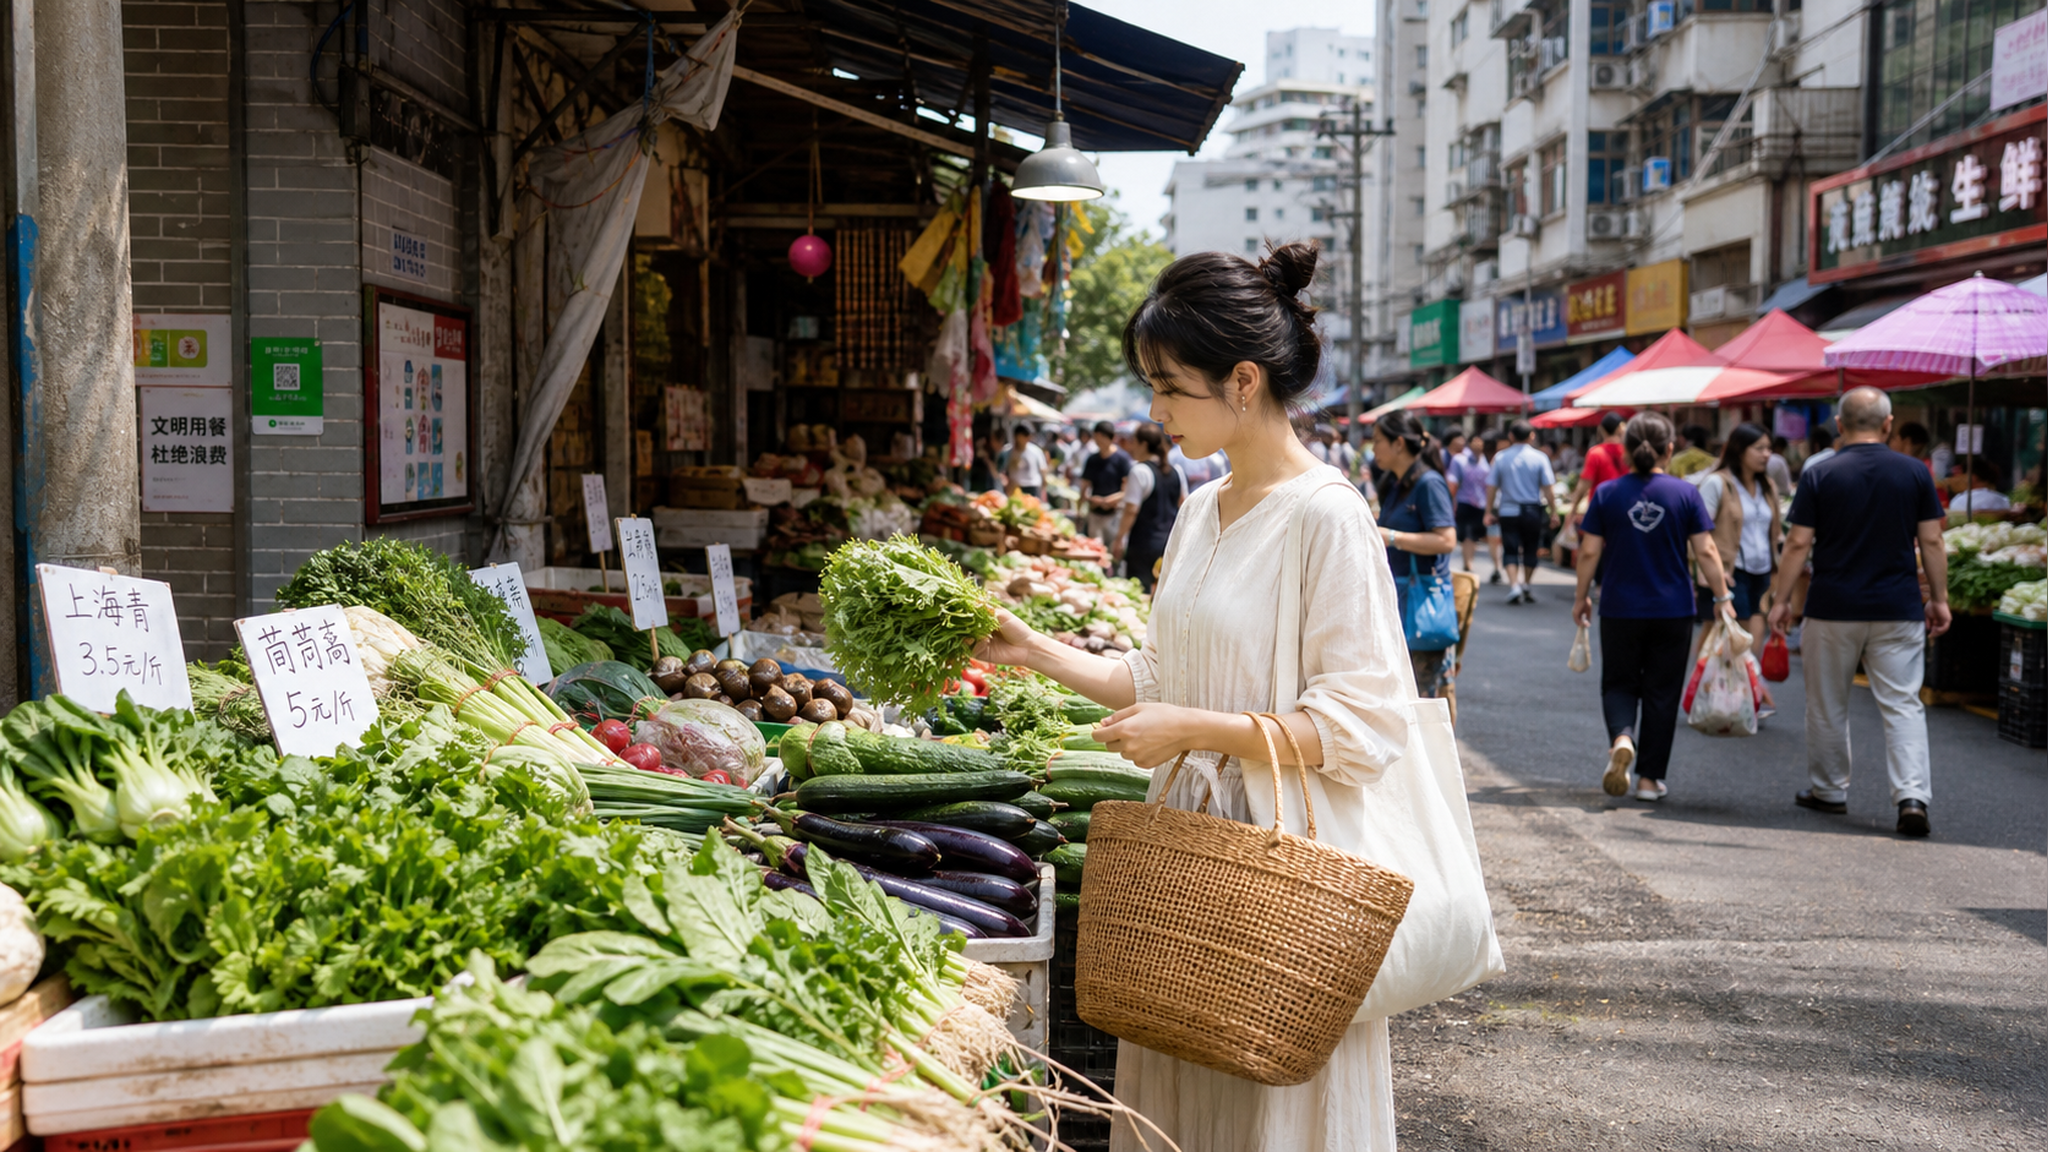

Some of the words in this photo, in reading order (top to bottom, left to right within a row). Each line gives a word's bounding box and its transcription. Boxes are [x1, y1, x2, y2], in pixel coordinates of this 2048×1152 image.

[151, 416, 226, 436] 文明用餐
[151, 445, 227, 465] 杜绝浪费
[65, 583, 149, 632] 上海青
[79, 641, 162, 685] 3.5元/斤
[286, 690, 355, 728] 5元/斤
